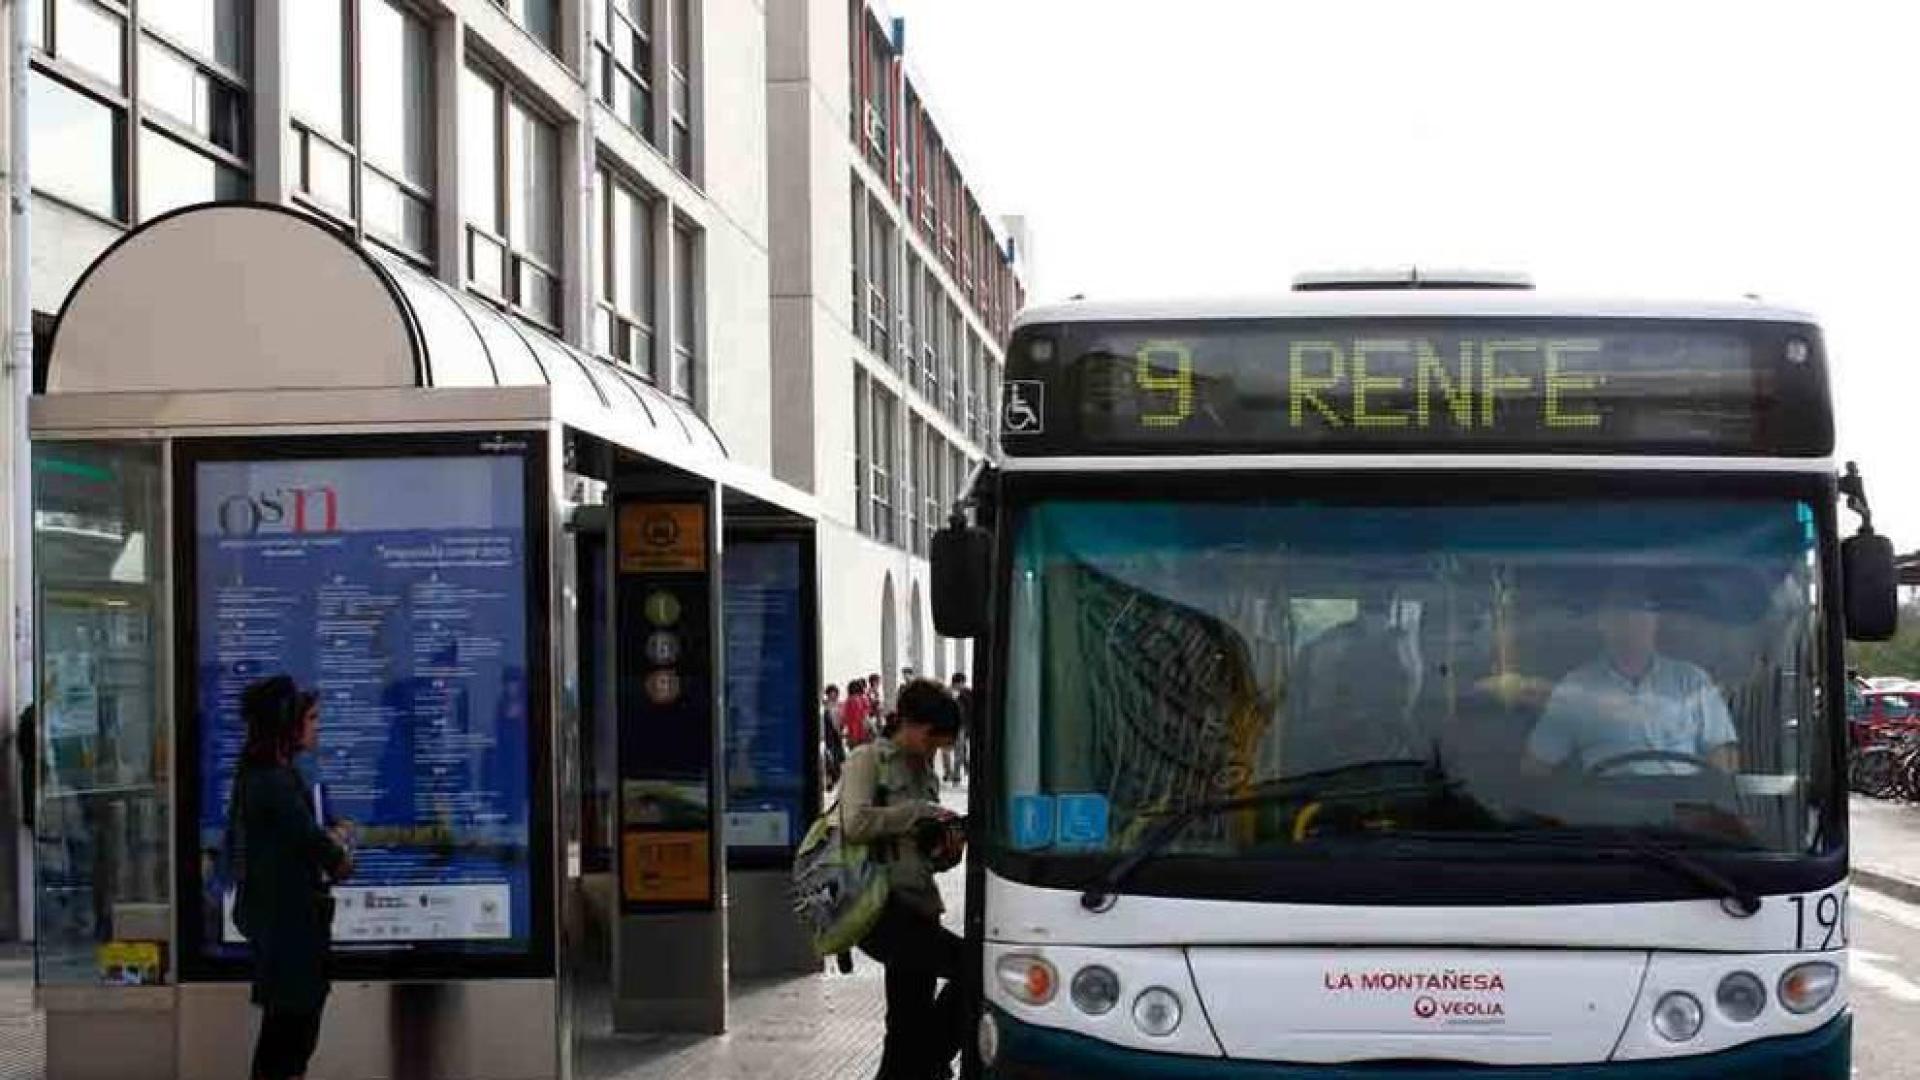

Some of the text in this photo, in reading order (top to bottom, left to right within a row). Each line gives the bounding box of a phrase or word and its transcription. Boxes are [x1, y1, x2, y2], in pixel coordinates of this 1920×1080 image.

[1135, 339, 1602, 429] 9 RENFE
[1324, 969, 1504, 990] LA MONTAÑESA
[1440, 1002, 1504, 1016] VEOLIA
